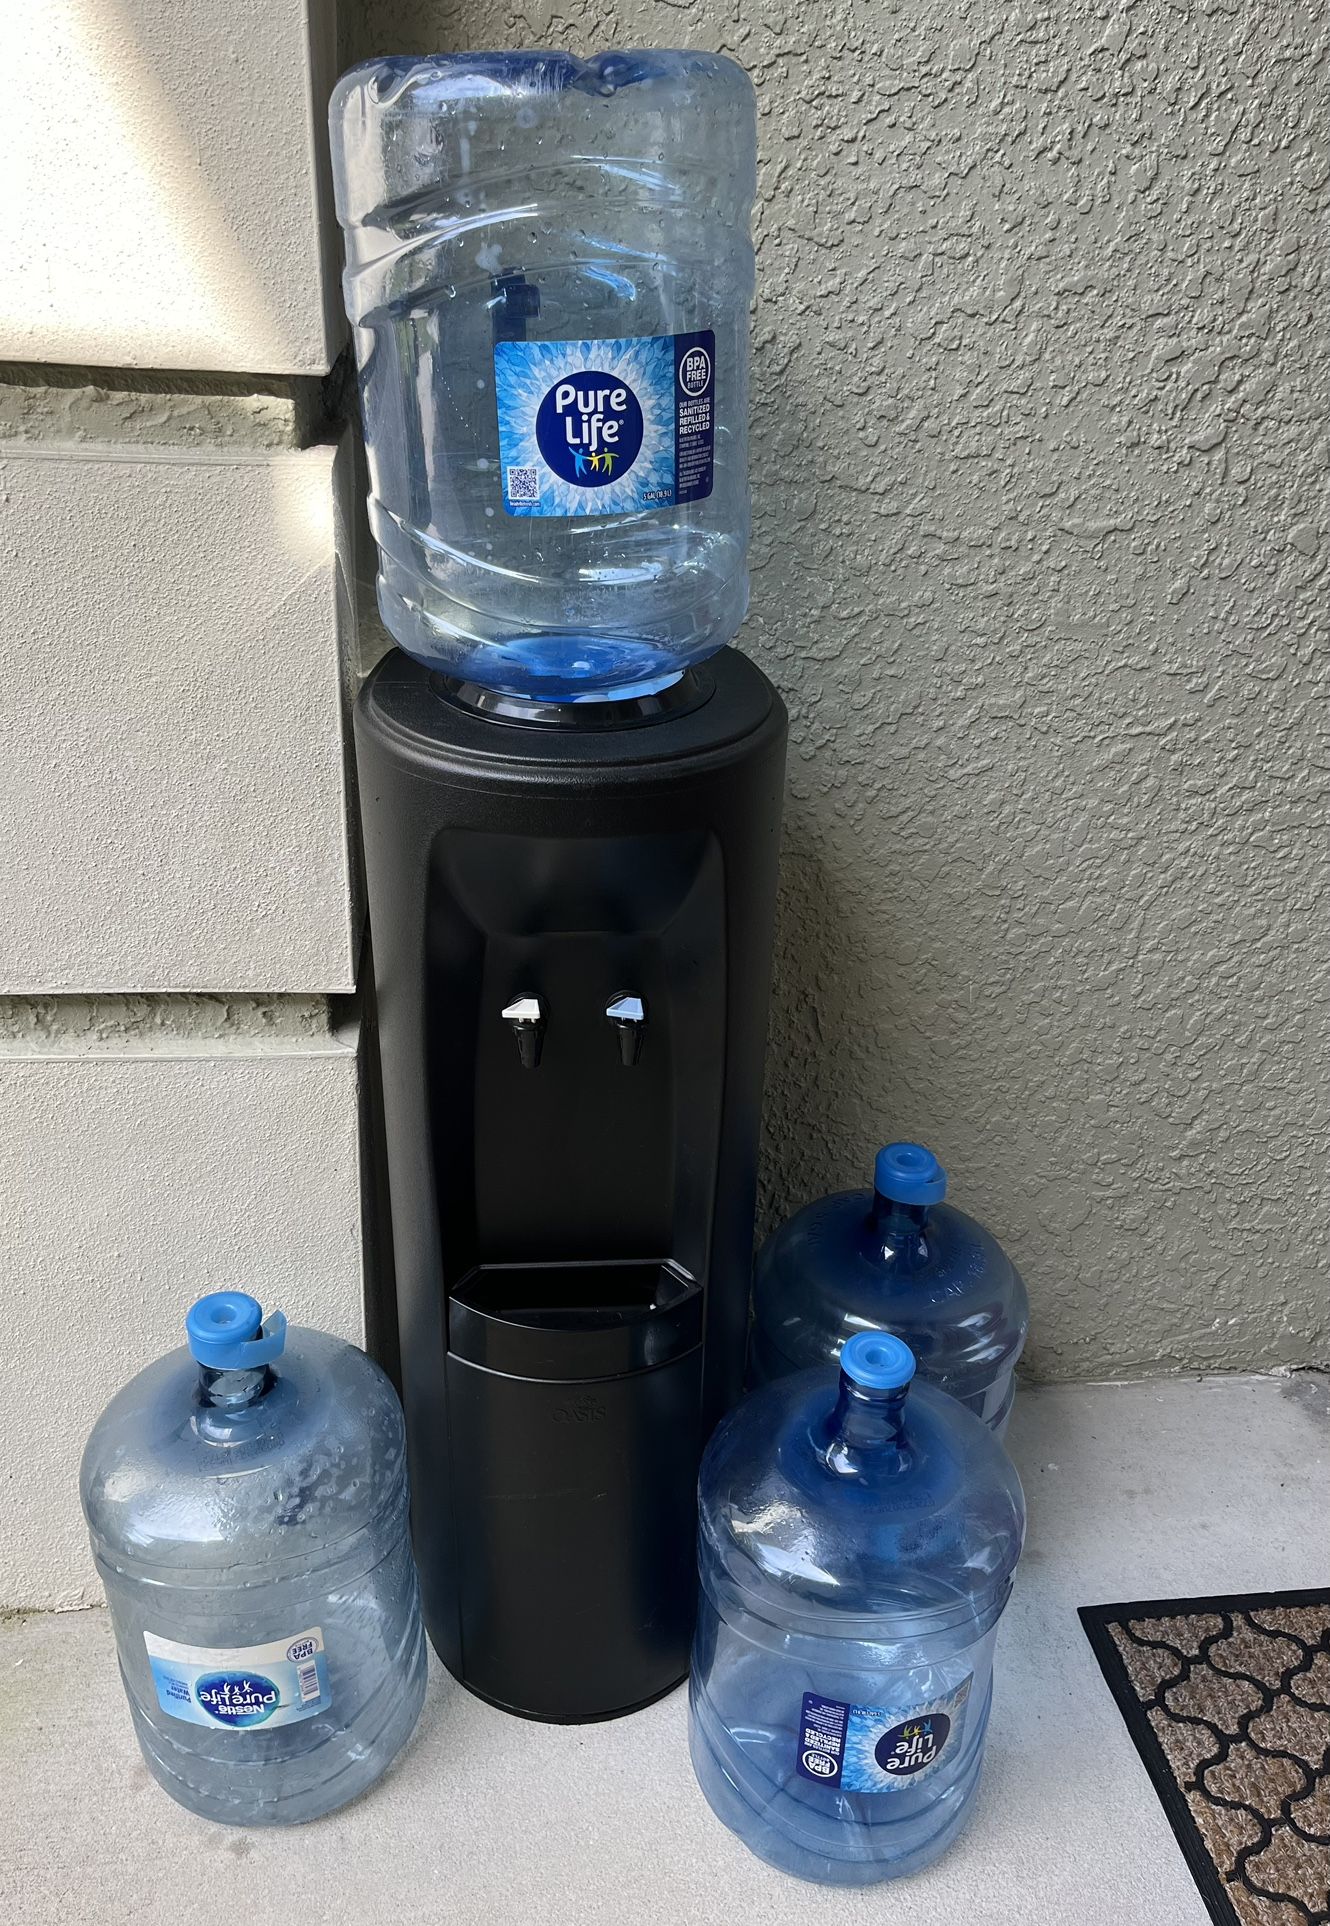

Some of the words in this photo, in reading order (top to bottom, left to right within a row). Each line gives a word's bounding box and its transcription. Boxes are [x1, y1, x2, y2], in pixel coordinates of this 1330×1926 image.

[686, 356, 706, 371] BPA
[686, 369, 706, 382] FREE
[687, 380, 704, 389] BOTTLE
[556, 384, 627, 414] Pure
[688, 398, 703, 407] BOTTLES
[679, 404, 710, 417] SANITIZED
[679, 413, 705, 426] REFILLED
[679, 421, 710, 435] RECYCLED
[292, 1641, 313, 1653] FREE
[293, 1647, 313, 1660] BPA
[170, 1685, 191, 1697] Water
[232, 1690, 276, 1705] Pure
[805, 1728, 841, 1743] RECYCLED
[810, 1734, 840, 1747] REFILLED
[805, 1738, 840, 1752] SANITIZED
[808, 1755, 831, 1768] FREE
[886, 1746, 936, 1770] Pure
[809, 1762, 830, 1775] BPA
